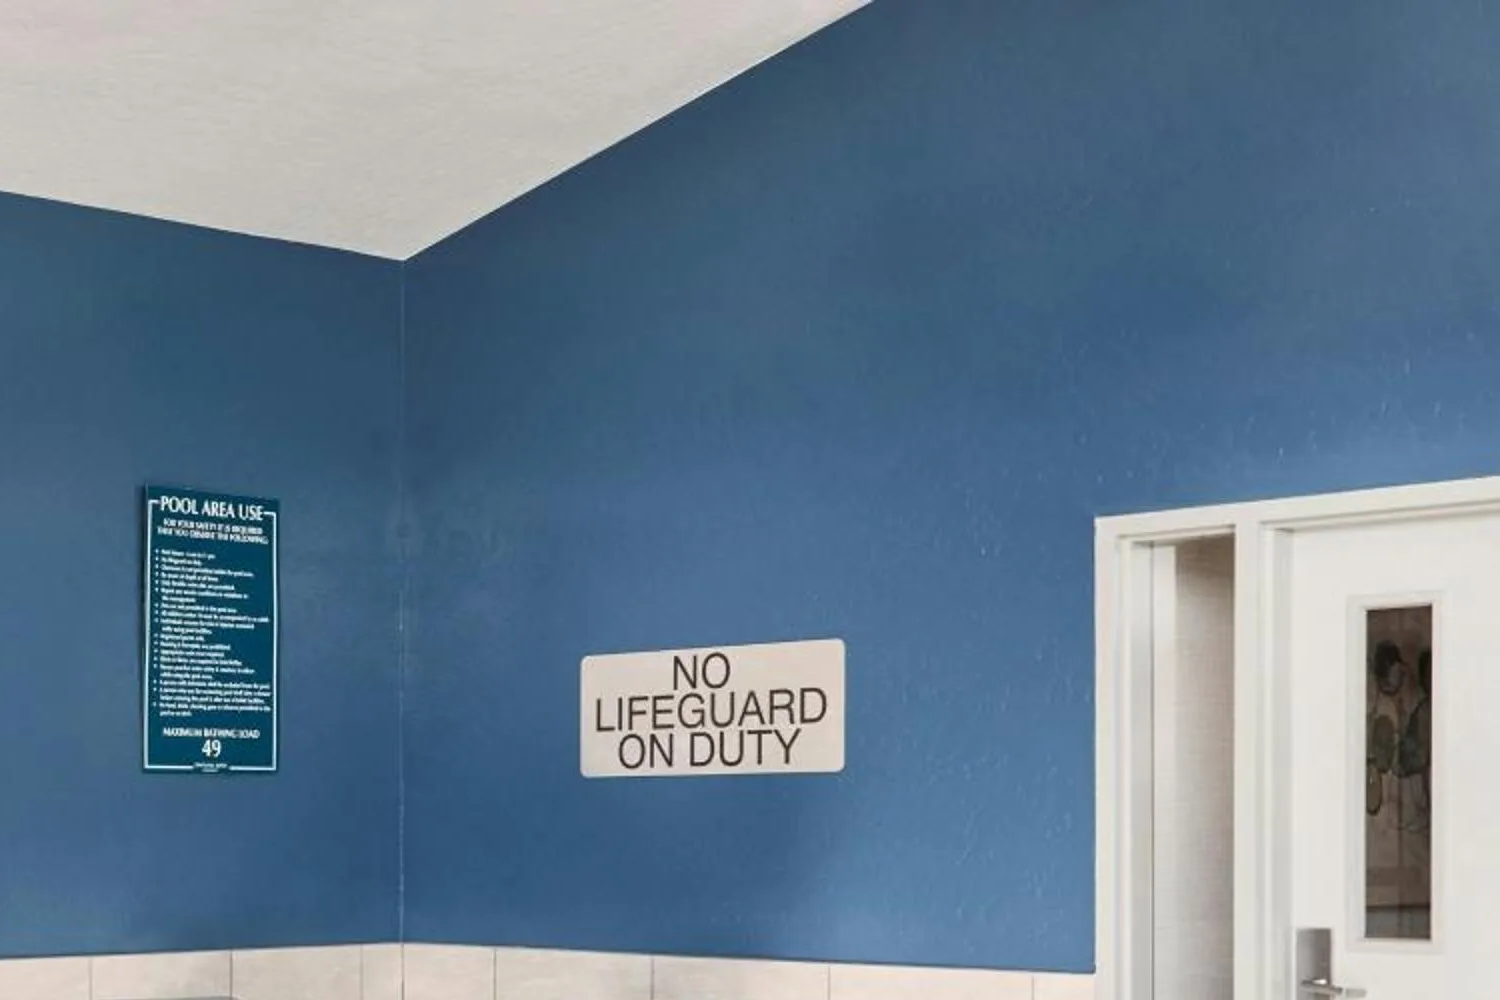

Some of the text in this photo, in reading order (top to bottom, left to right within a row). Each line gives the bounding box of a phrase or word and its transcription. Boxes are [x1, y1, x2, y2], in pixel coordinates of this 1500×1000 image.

[160, 495, 263, 521] POOL AREA USE
[673, 652, 731, 690] NO
[596, 687, 827, 732] LIFEGUARD
[201, 739, 220, 757] 49
[619, 728, 802, 769] ON DUTY
